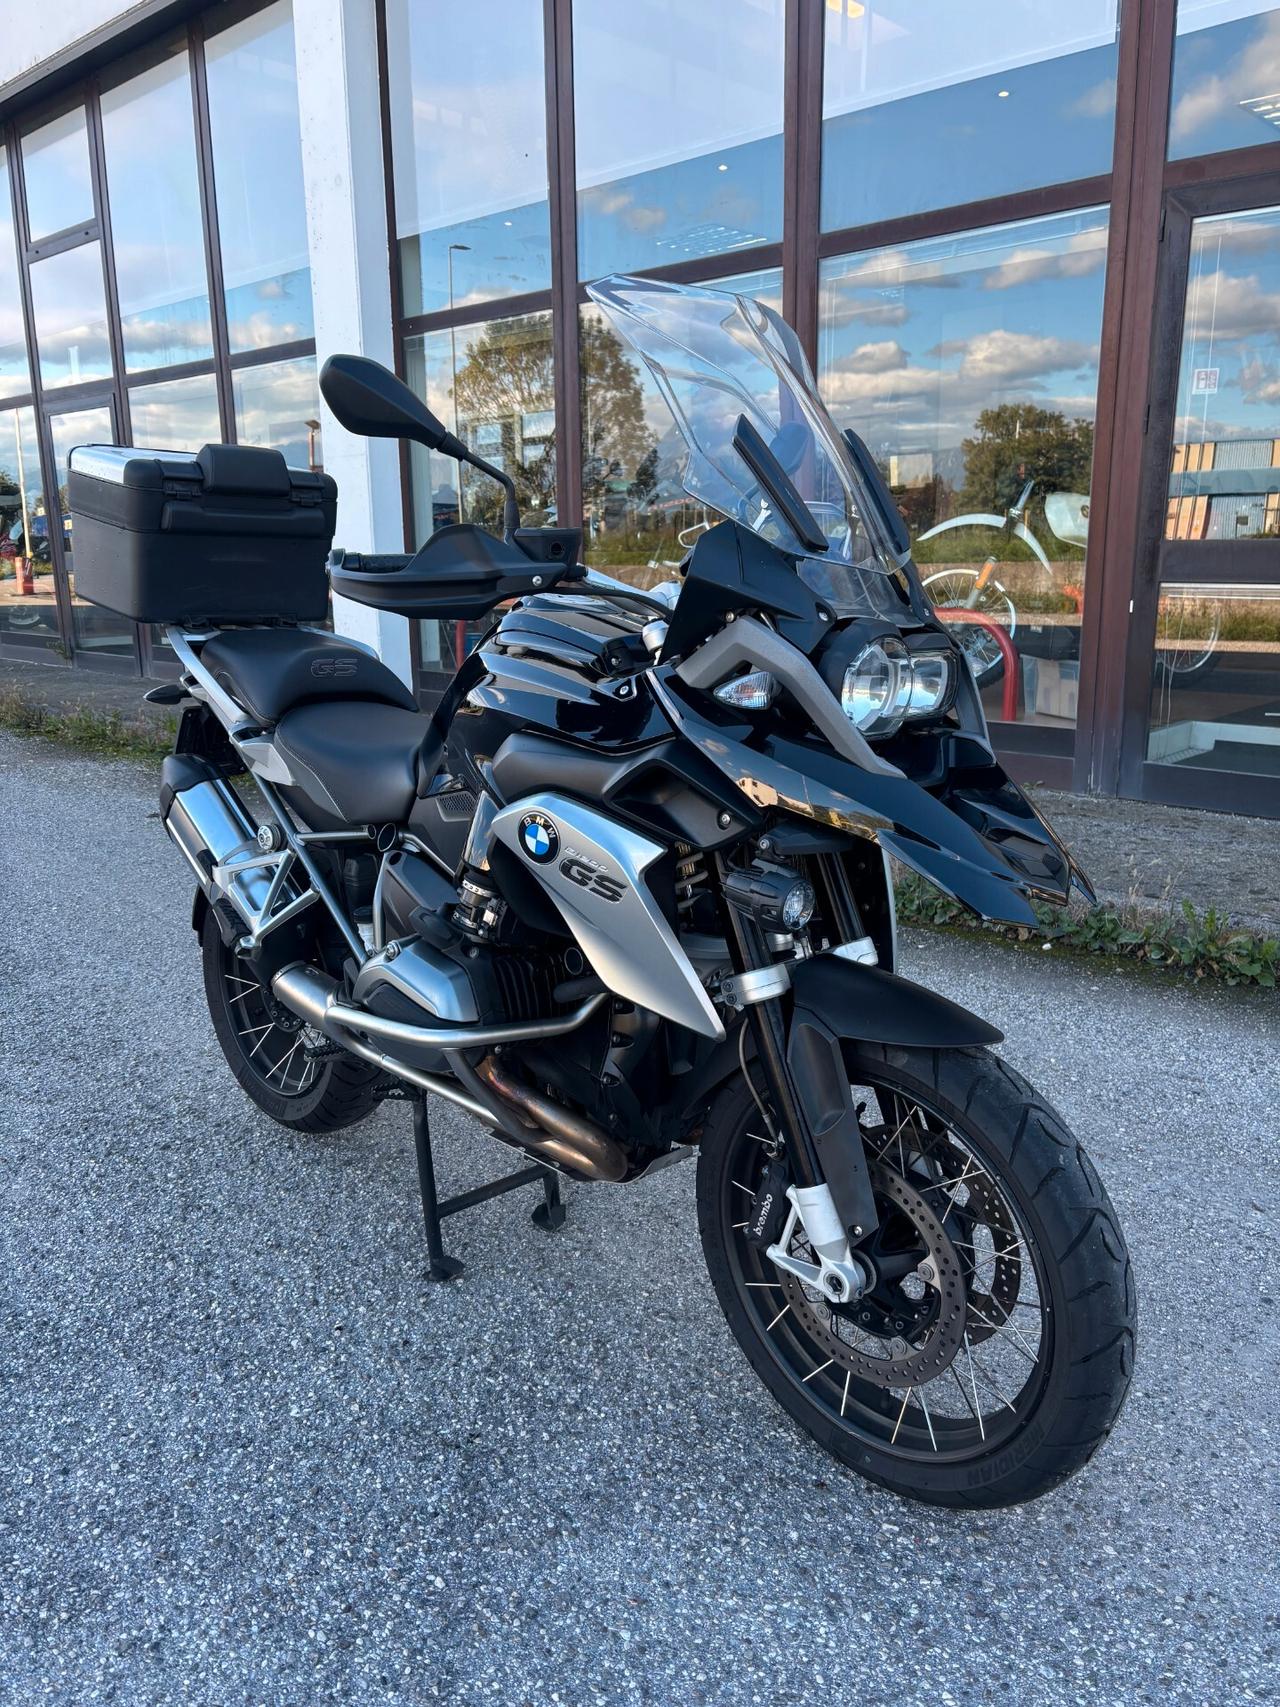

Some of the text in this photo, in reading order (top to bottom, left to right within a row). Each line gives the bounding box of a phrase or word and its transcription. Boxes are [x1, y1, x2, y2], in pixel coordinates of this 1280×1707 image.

[311, 658, 358, 678] GS
[523, 816, 556, 838] BMW
[559, 857, 627, 904] GS
[753, 1193, 773, 1236] brembo
